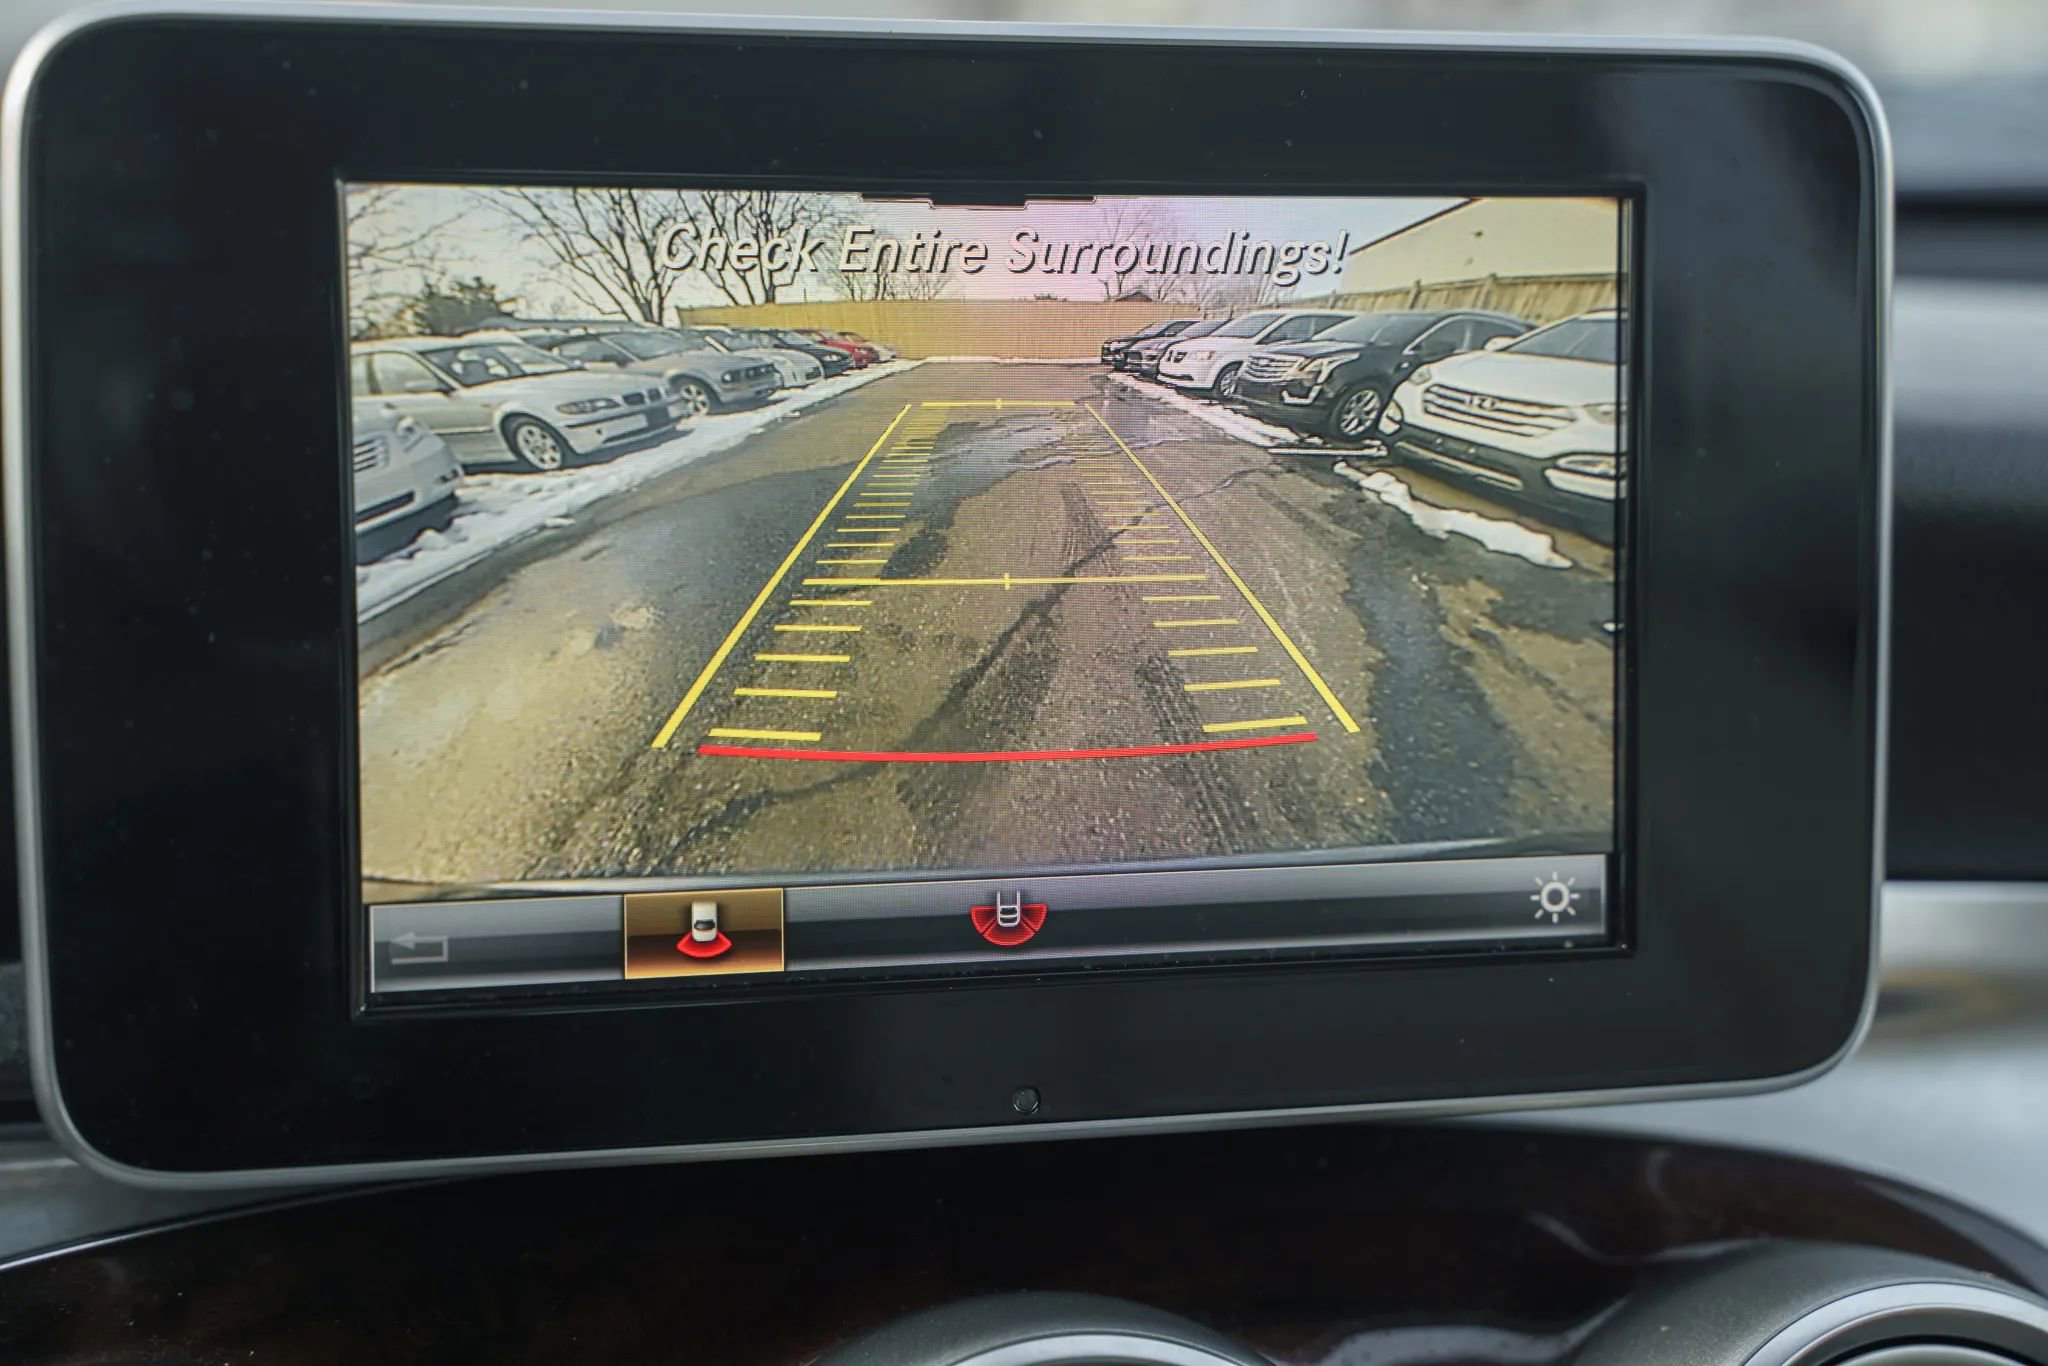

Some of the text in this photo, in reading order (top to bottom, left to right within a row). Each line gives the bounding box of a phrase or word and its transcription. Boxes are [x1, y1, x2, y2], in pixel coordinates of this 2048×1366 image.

[659, 225, 1349, 286] Check Entire Surroundings!
